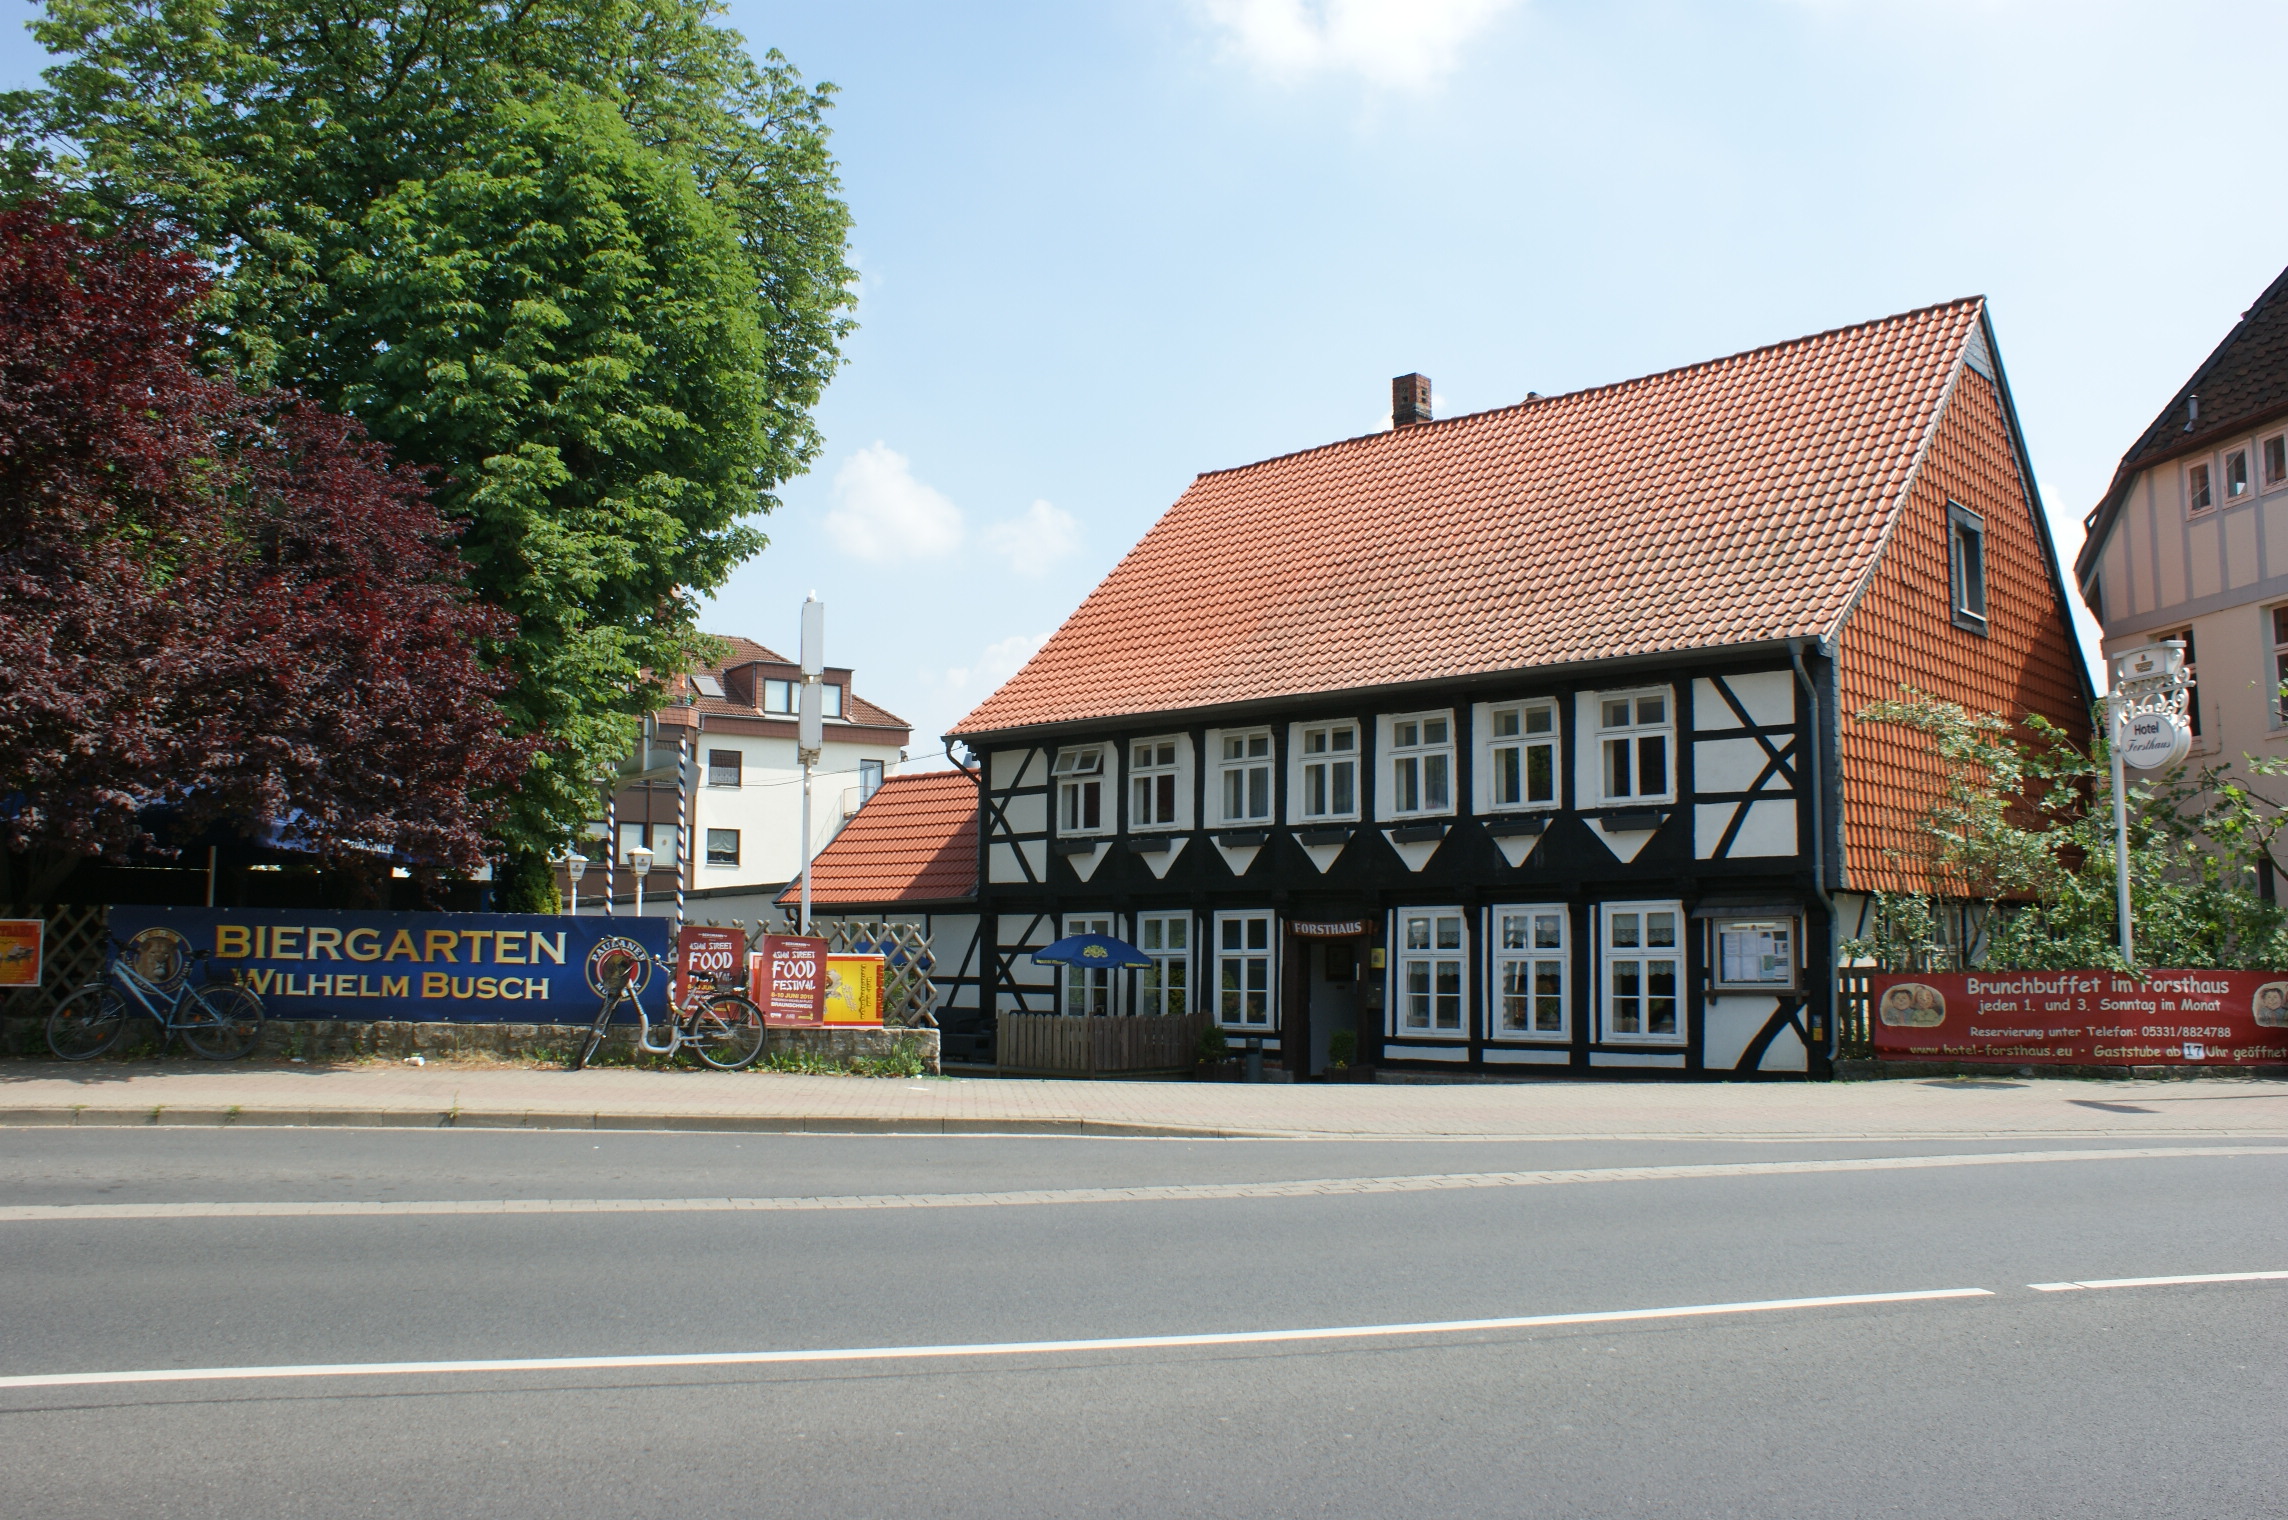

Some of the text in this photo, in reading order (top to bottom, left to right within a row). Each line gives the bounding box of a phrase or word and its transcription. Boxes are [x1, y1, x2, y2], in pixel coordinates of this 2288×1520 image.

[2134, 721, 2159, 736] Hotel
[2125, 737, 2171, 753] Forsthaus
[1294, 921, 1362, 935] FORSTHAUS
[214, 925, 567, 965] BIERGARTEN
[591, 940, 647, 962] PAULANER
[708, 942, 732, 950] STREET
[688, 951, 733, 970] FOOD
[792, 951, 815, 959] STREET
[772, 960, 816, 979] FOOD
[231, 968, 550, 1000] WILHELM BUSCH
[772, 980, 816, 991] FESTIVAL
[1967, 975, 2230, 995] Brunchbuffet im Forsthaus
[770, 1001, 813, 1009] BRAUNSCHWEIG
[1977, 998, 2221, 1016] jeden 1. und 3. Sonntag im Monat
[1969, 1026, 2232, 1040] Reservierung unter Telefon: 05331/8824788
[1909, 1044, 2287, 1062] www.hotel-forsthaus.eu Gaststube ab 17 Uhr geöffnet
